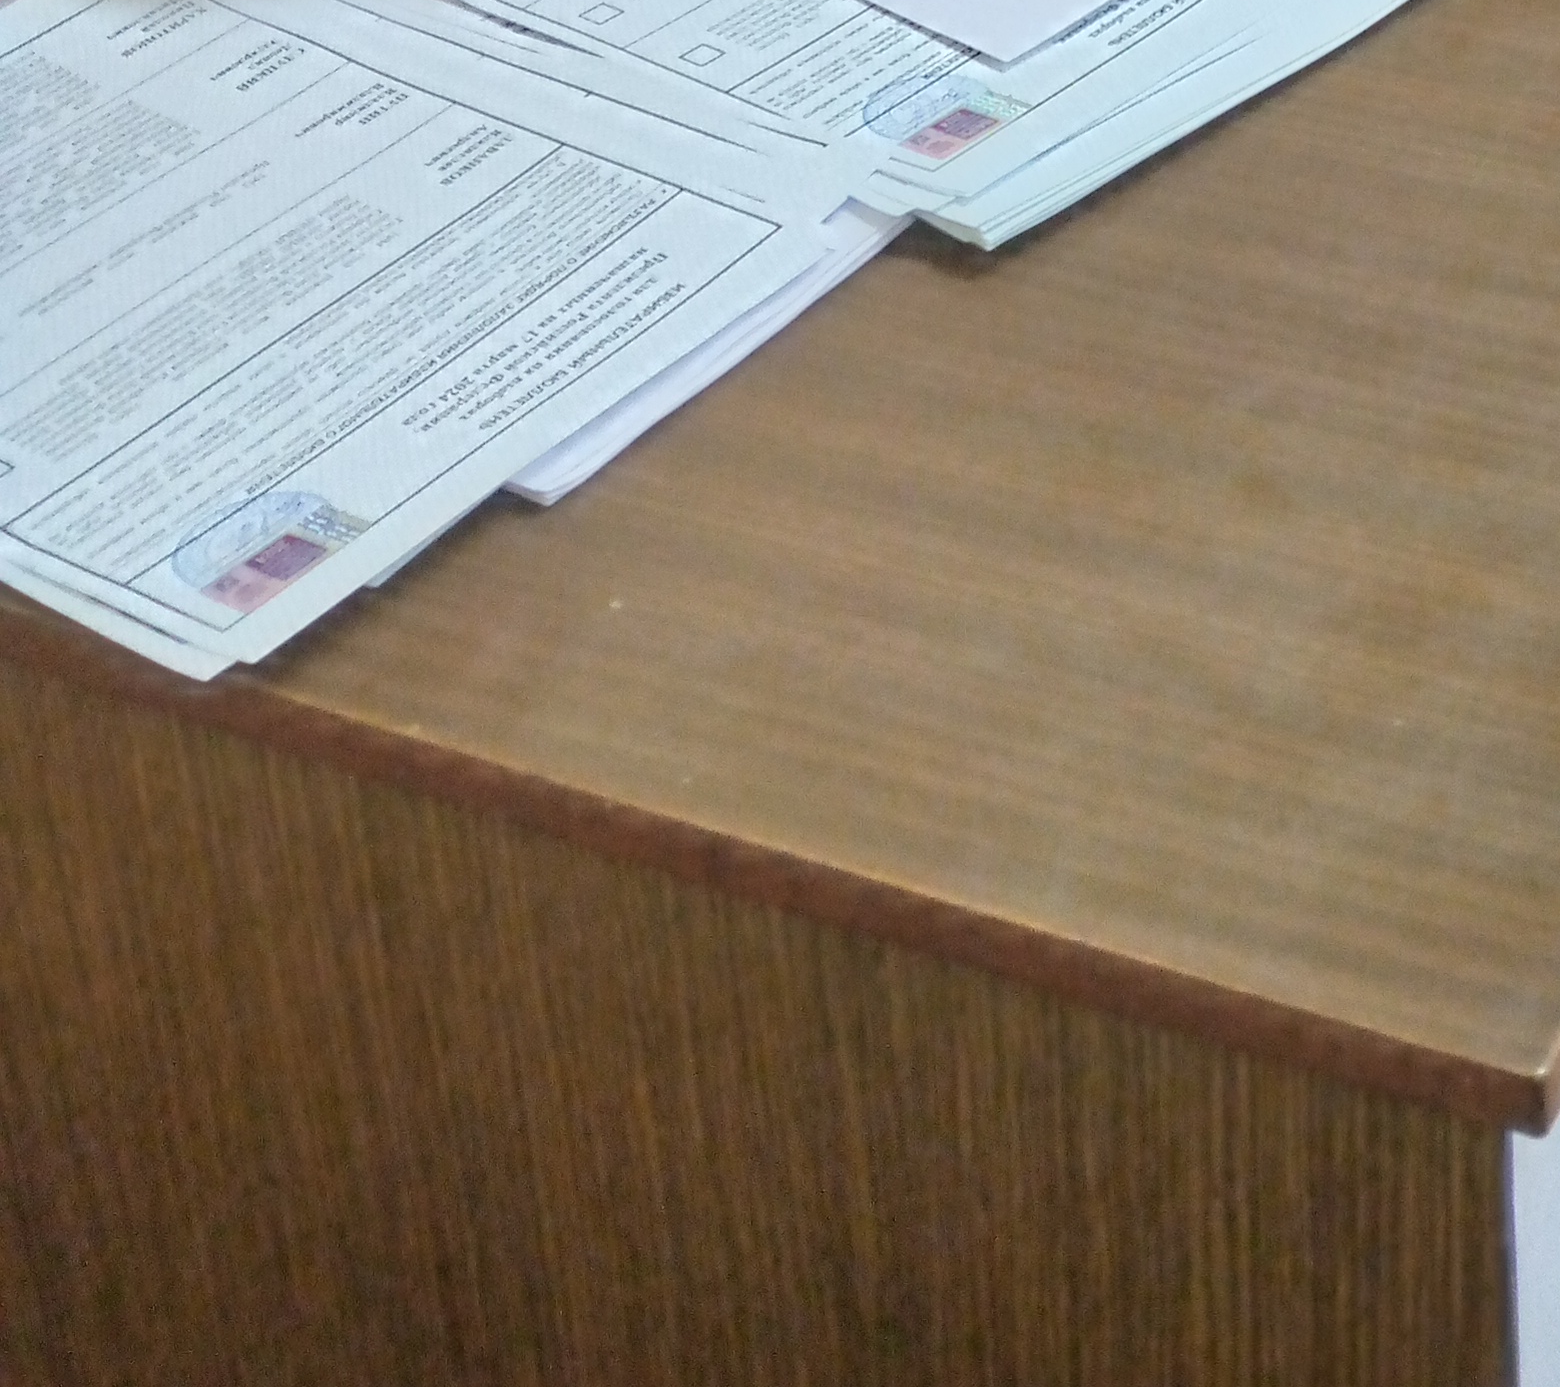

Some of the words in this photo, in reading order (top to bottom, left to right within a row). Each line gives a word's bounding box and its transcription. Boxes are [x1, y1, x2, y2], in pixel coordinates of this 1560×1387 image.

[563, 282, 691, 370] ИЗБИРАТЕЛЬНЫЙ
[434, 375, 477, 402] 2024
[475, 367, 571, 432] БЮЛЛЕТЕНЬ
